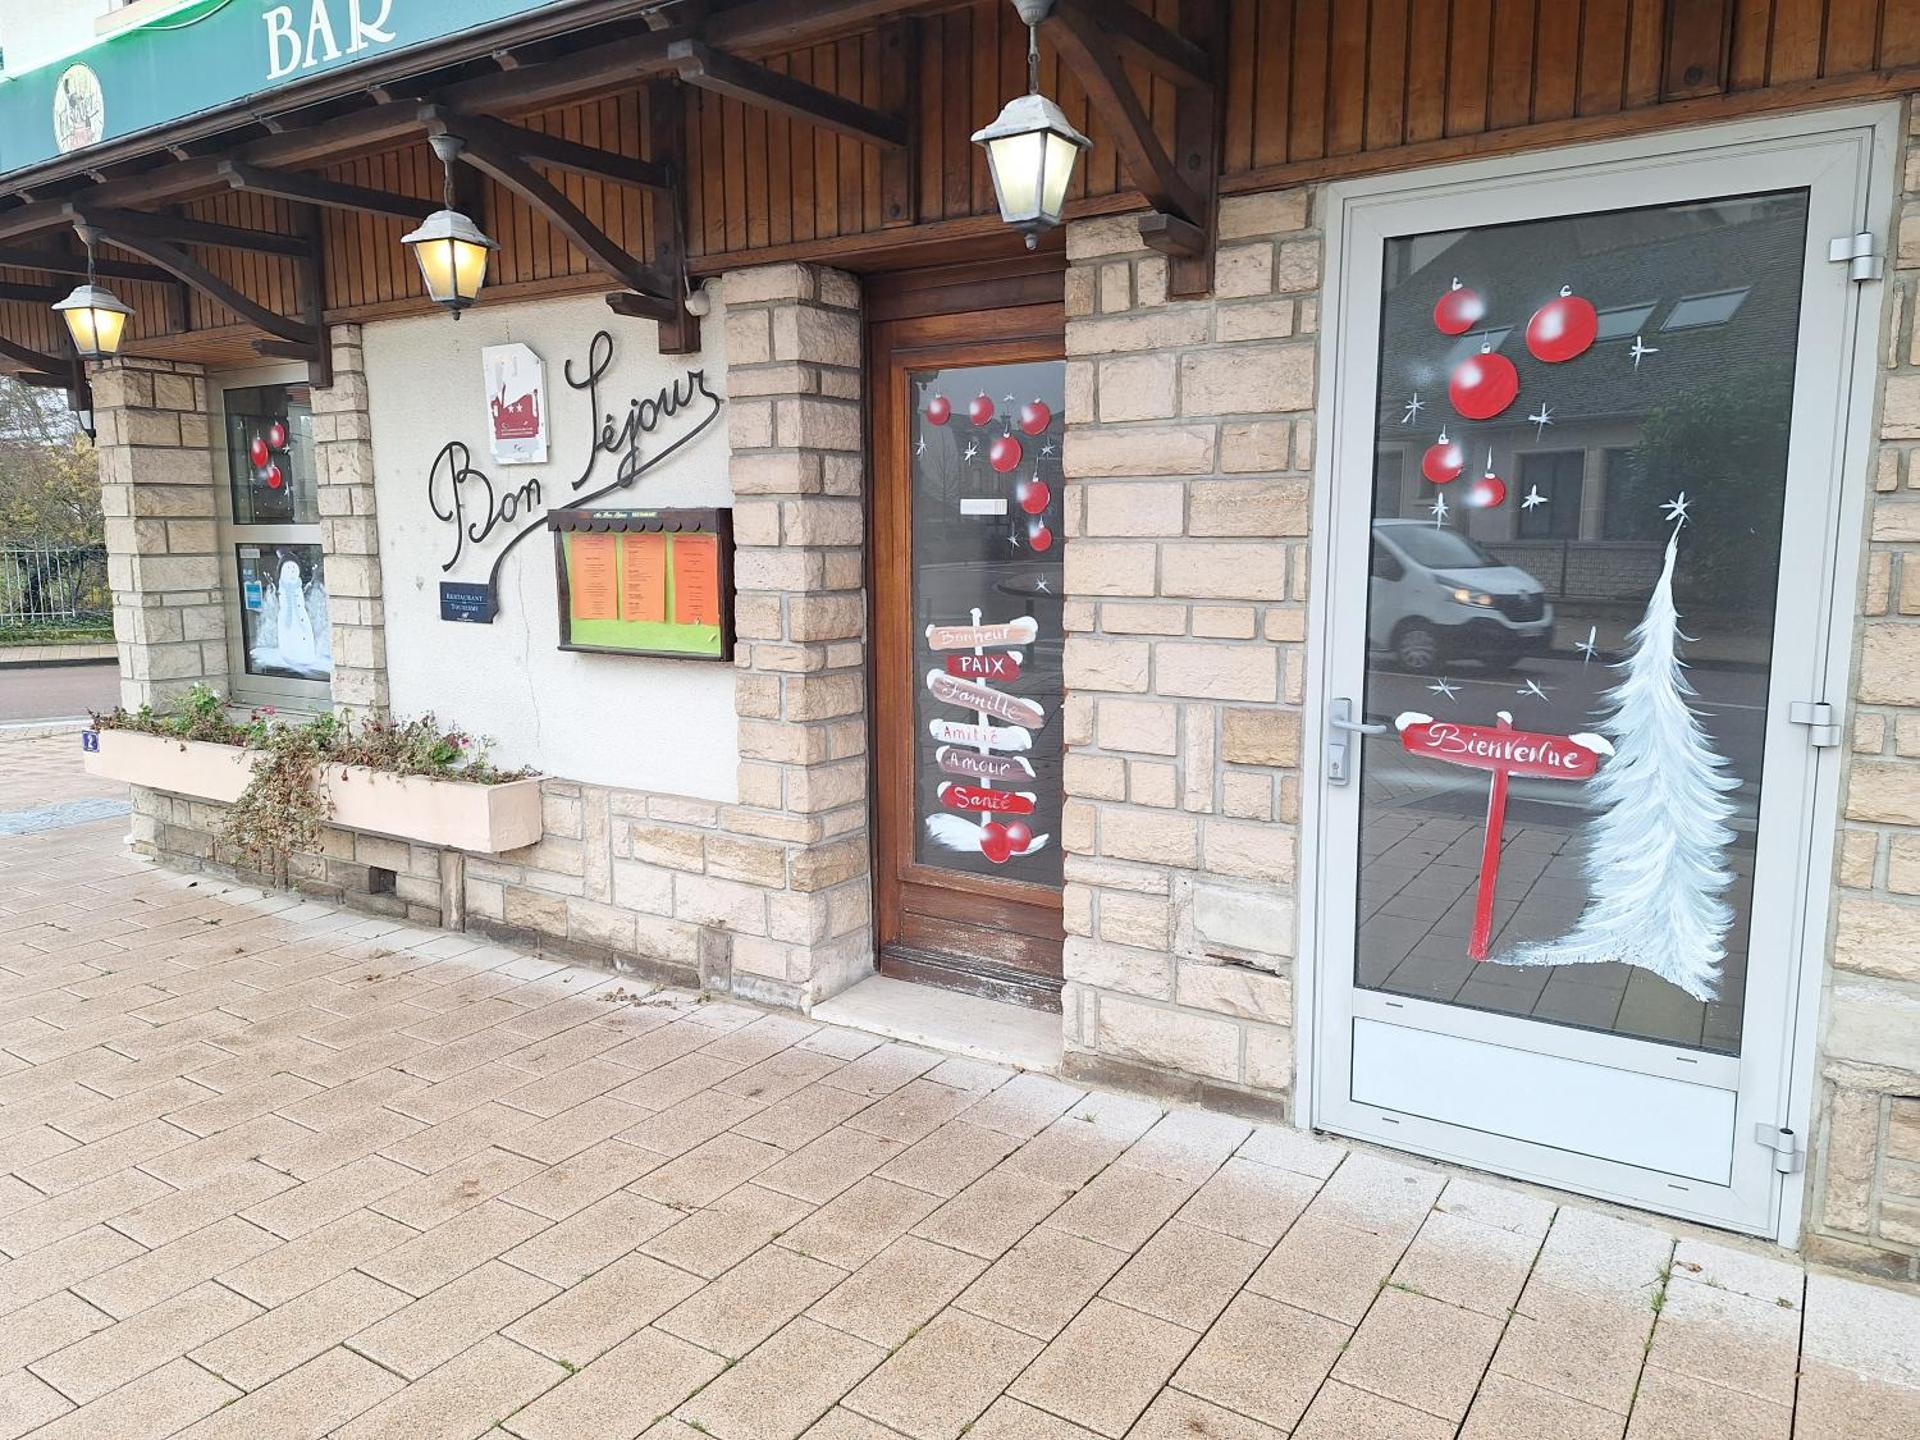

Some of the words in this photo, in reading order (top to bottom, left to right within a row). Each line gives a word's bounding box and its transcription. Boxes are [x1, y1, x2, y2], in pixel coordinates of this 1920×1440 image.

[262, 0, 396, 80] BAR
[428, 441, 542, 573] Bon
[564, 330, 720, 491] Séjour
[941, 628, 1009, 645] Bonheur
[959, 656, 1006, 675] PAIX
[941, 680, 1019, 719] Famille
[87, 734, 94, 749] 2
[944, 725, 999, 744] Amitié
[1425, 723, 1582, 769] Bienvenue
[949, 752, 1011, 776] Amour
[953, 786, 1011, 809] Santé
